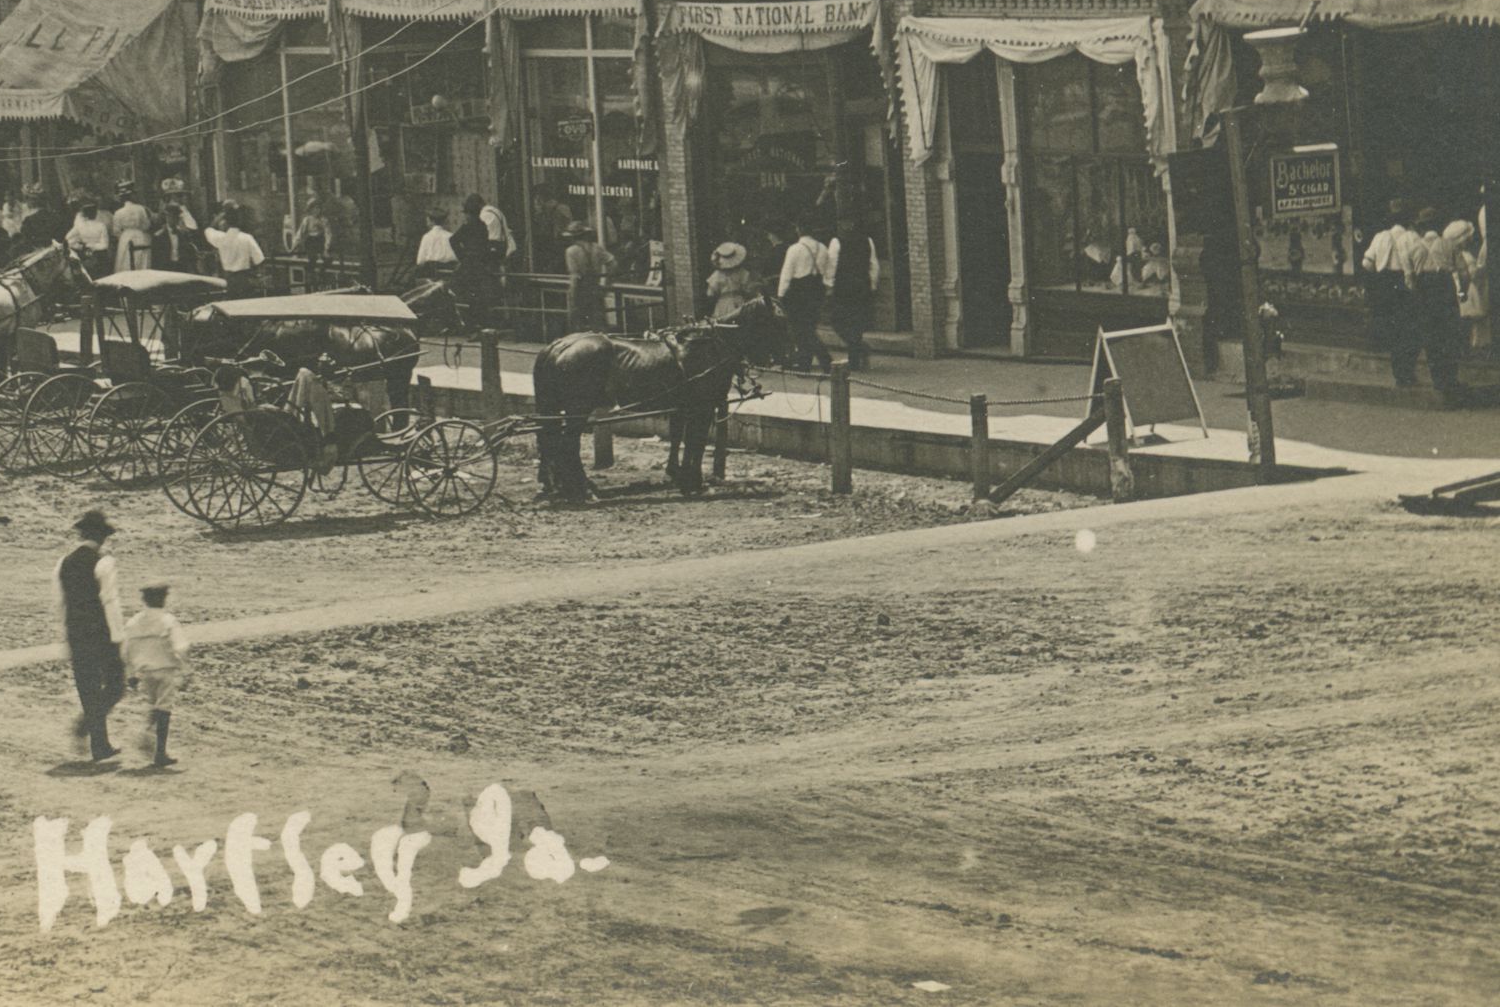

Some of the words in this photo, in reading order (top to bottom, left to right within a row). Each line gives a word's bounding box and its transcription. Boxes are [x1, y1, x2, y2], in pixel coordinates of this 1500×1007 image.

[678, 4, 723, 27] FIRST
[732, 4, 815, 27] NATIONAL
[1276, 158, 1331, 189] Bachelor
[586, 185, 633, 198] IMLEMENTS
[1301, 181, 1329, 195] CIGAR
